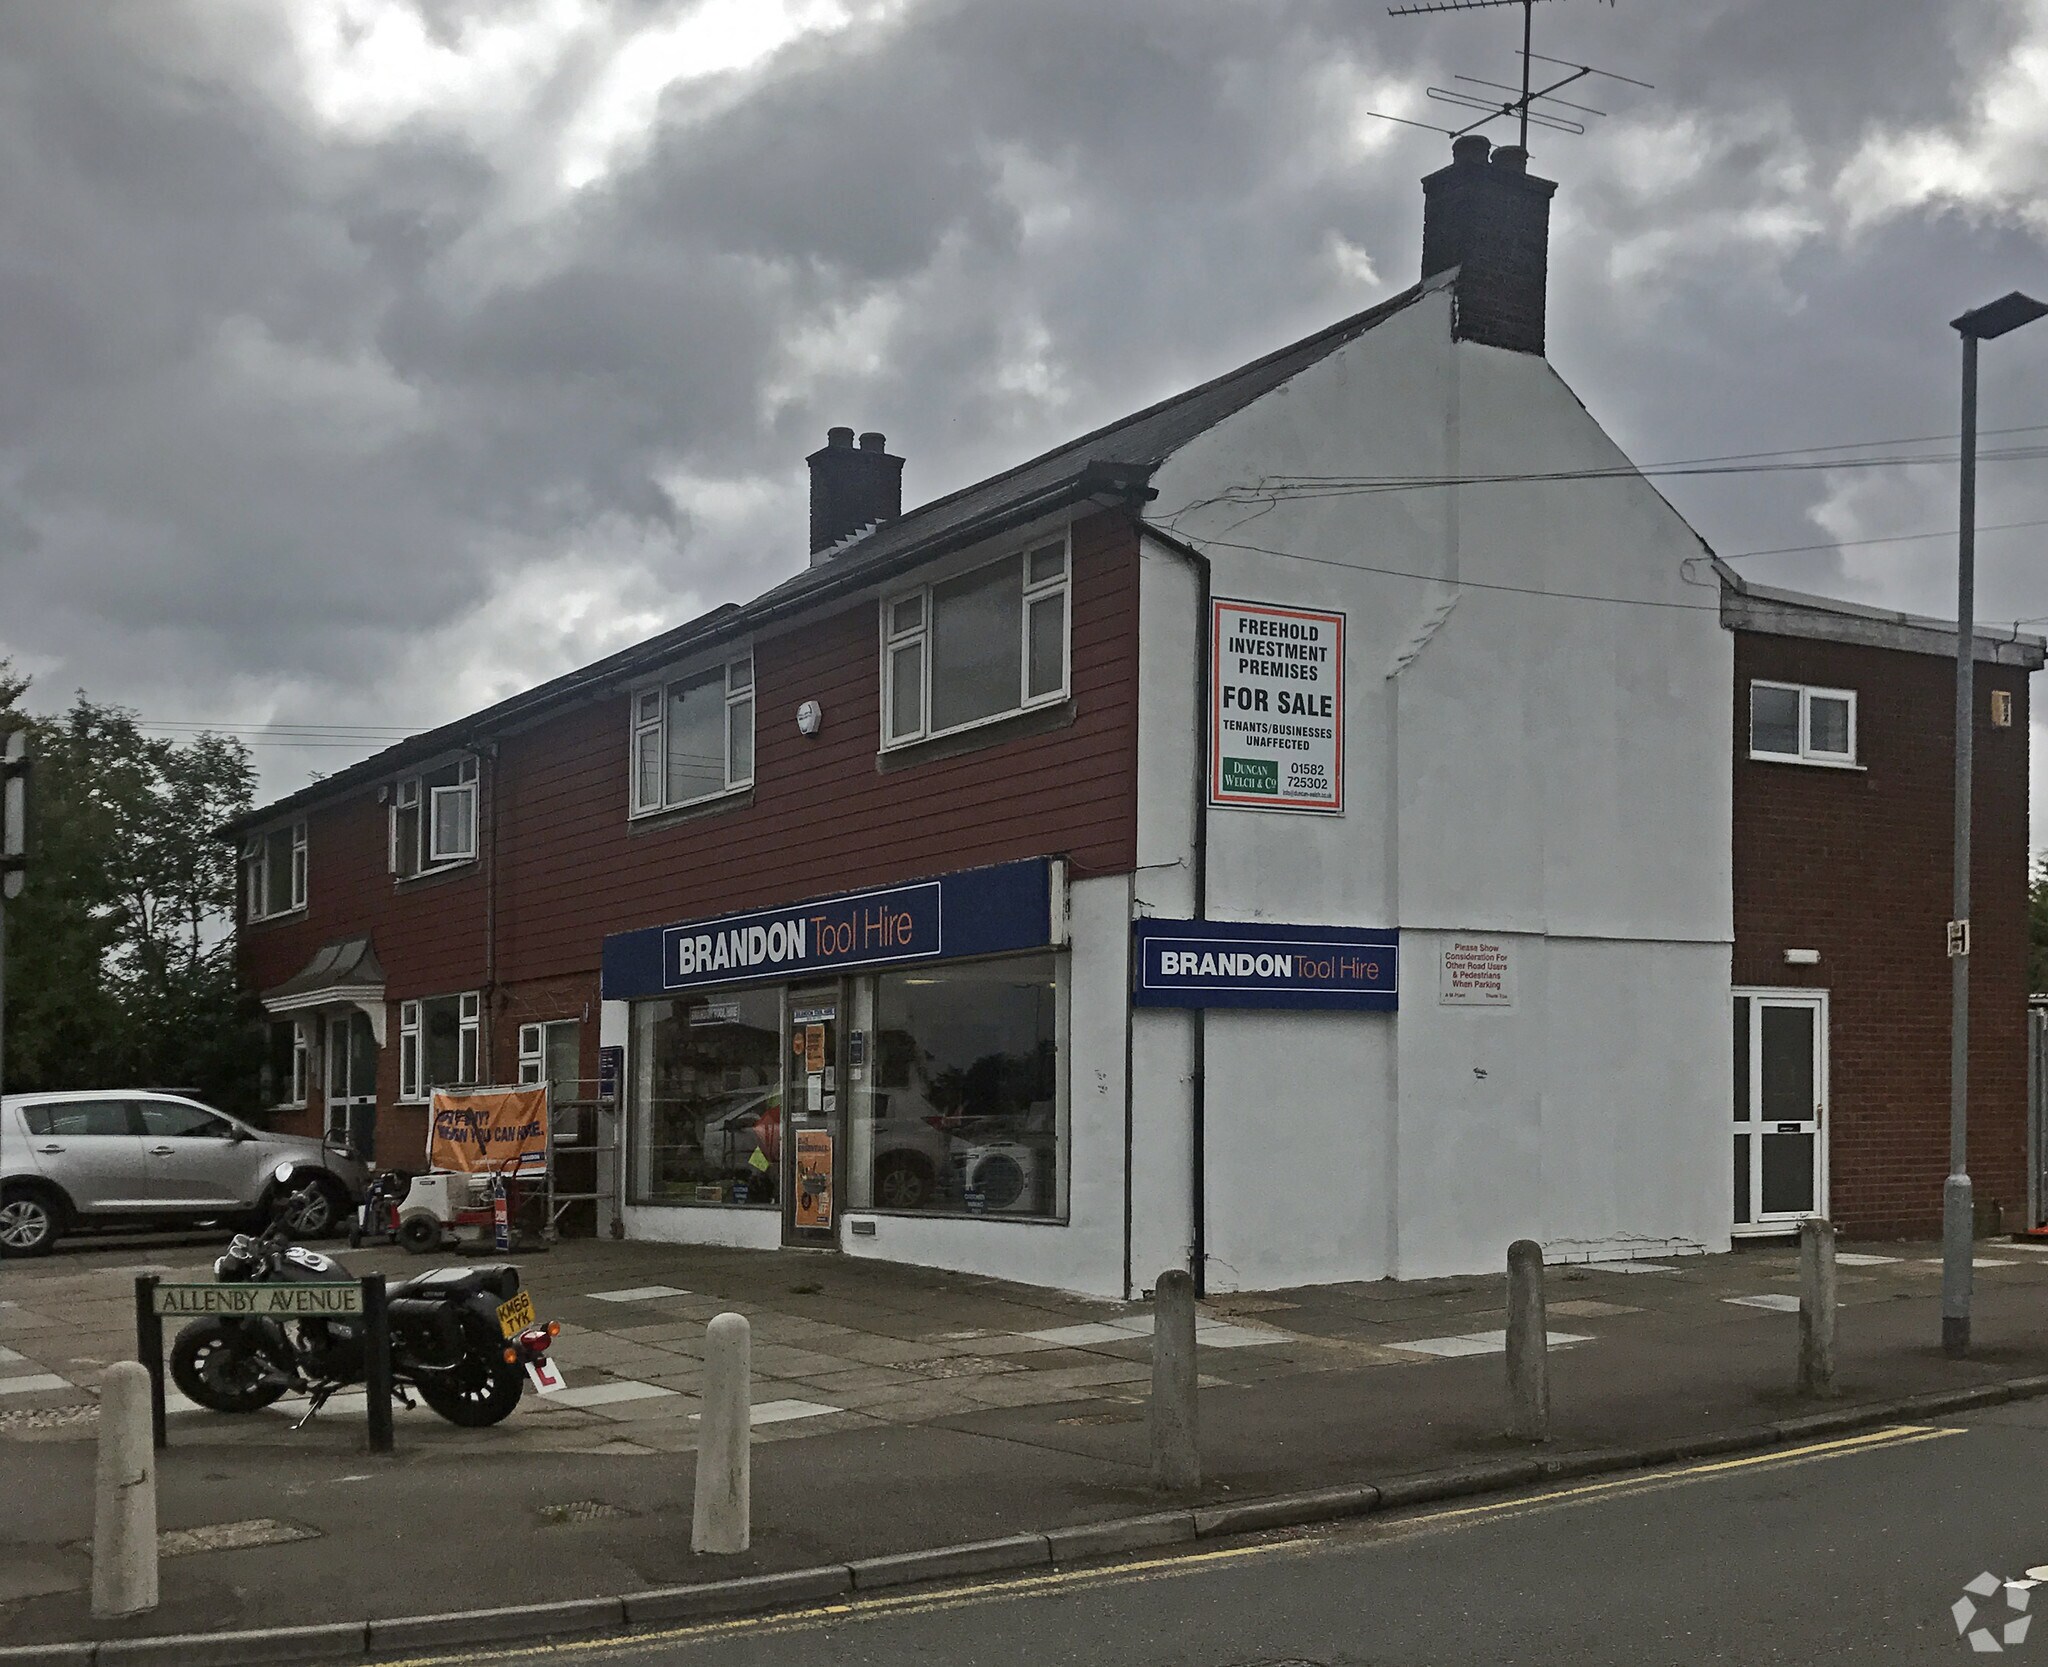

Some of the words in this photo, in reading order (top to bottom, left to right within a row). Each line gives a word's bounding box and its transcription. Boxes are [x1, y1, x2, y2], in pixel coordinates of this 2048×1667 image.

[1239, 618, 1319, 641] FREEHOLD
[1229, 637, 1327, 662] INVESTMENT
[1239, 658, 1318, 681] PREMISES
[1223, 685, 1269, 712] FOR
[1278, 691, 1332, 717] SALE
[1223, 719, 1332, 739] TENANTS/BUSINESSES
[1246, 736, 1310, 750] UNAFFECTED
[1234, 762, 1267, 775] DUNCAN
[1291, 762, 1324, 775] 01582
[1225, 774, 1255, 788] WELCH
[1257, 779, 1262, 788] &
[1288, 776, 1328, 789] 725302
[679, 917, 806, 975] BRANDON
[811, 911, 857, 956] Tool
[865, 906, 912, 948] Hire
[1455, 943, 1478, 952] Please
[1480, 944, 1499, 952] Show
[1445, 952, 1494, 961] Consideration
[1162, 951, 1292, 978] BRANDON
[1295, 955, 1335, 979] Tool
[1340, 957, 1379, 980] Hire
[1446, 961, 1465, 969] Other
[1468, 962, 1485, 970] Road
[1460, 971, 1501, 979] Pedestrians
[1453, 980, 1472, 988] When
[1475, 981, 1501, 990] Parking
[495, 1126, 515, 1142] CAN
[163, 1290, 259, 1311] ALLENBY
[269, 1289, 355, 1311] AVENUE
[499, 1294, 529, 1321] KM66
[507, 1310, 531, 1332] TYK
